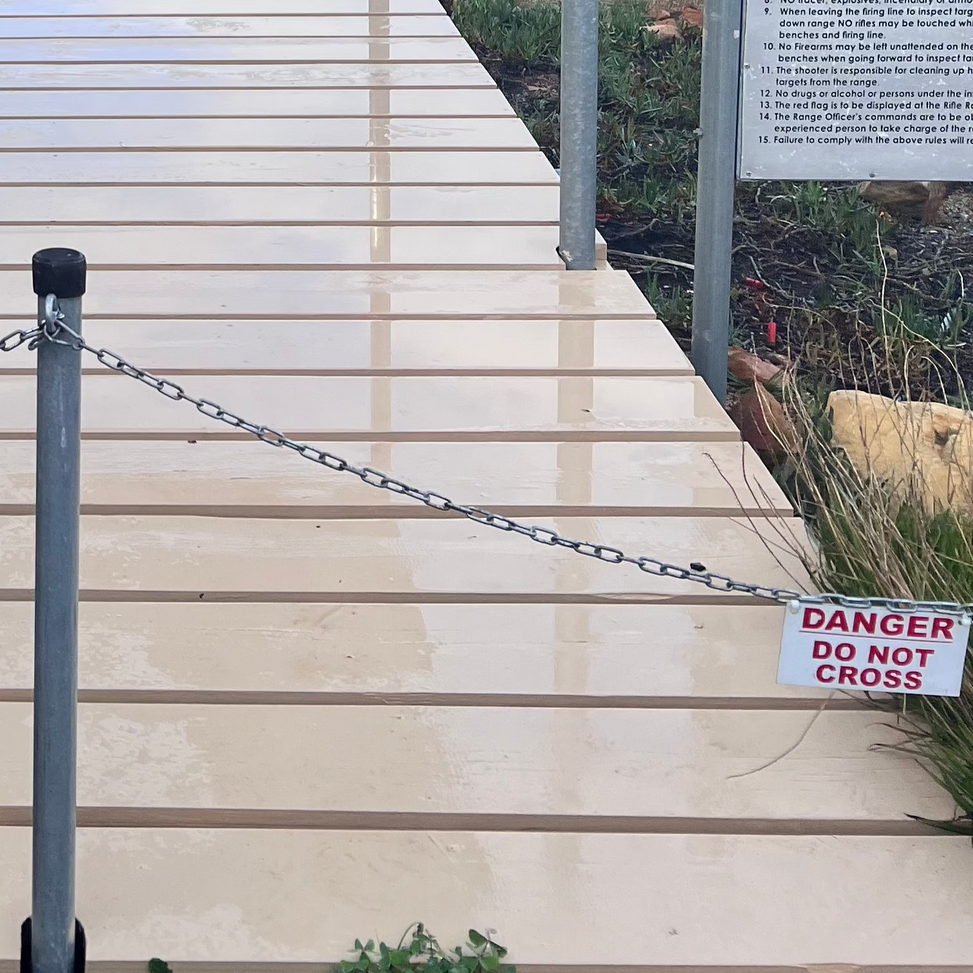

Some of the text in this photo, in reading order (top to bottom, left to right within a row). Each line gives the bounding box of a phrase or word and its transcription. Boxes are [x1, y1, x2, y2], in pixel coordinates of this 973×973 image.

[780, 7, 952, 18] When leaving the firing line inspect
[779, 19, 956, 30] down range NO rifles may be touched
[779, 30, 819, 39] benches
[821, 30, 840, 39] and
[842, 30, 865, 41] firing
[779, 42, 944, 53] No Firearms may left unattended
[778, 54, 960, 65] benches when going forward inspect
[776, 66, 965, 77] The shooter responsible for cleaning up
[776, 78, 807, 89] targets
[810, 78, 831, 86] from
[833, 78, 848, 86] the
[775, 89, 962, 100] No drugs alcohol persons under the
[775, 101, 962, 112] The red flag be displayed the Rifle
[775, 113, 790, 121] The
[793, 113, 822, 123] Range
[825, 113, 862, 121] Officer's
[865, 113, 917, 121] commands
[949, 113, 962, 121] be
[774, 124, 966, 135] experienced person take charge the
[774, 135, 964, 146] Failure comply with the above rules will
[802, 607, 954, 640] DANGER
[812, 640, 935, 667] DO NOT
[816, 664, 923, 690] CROSS
